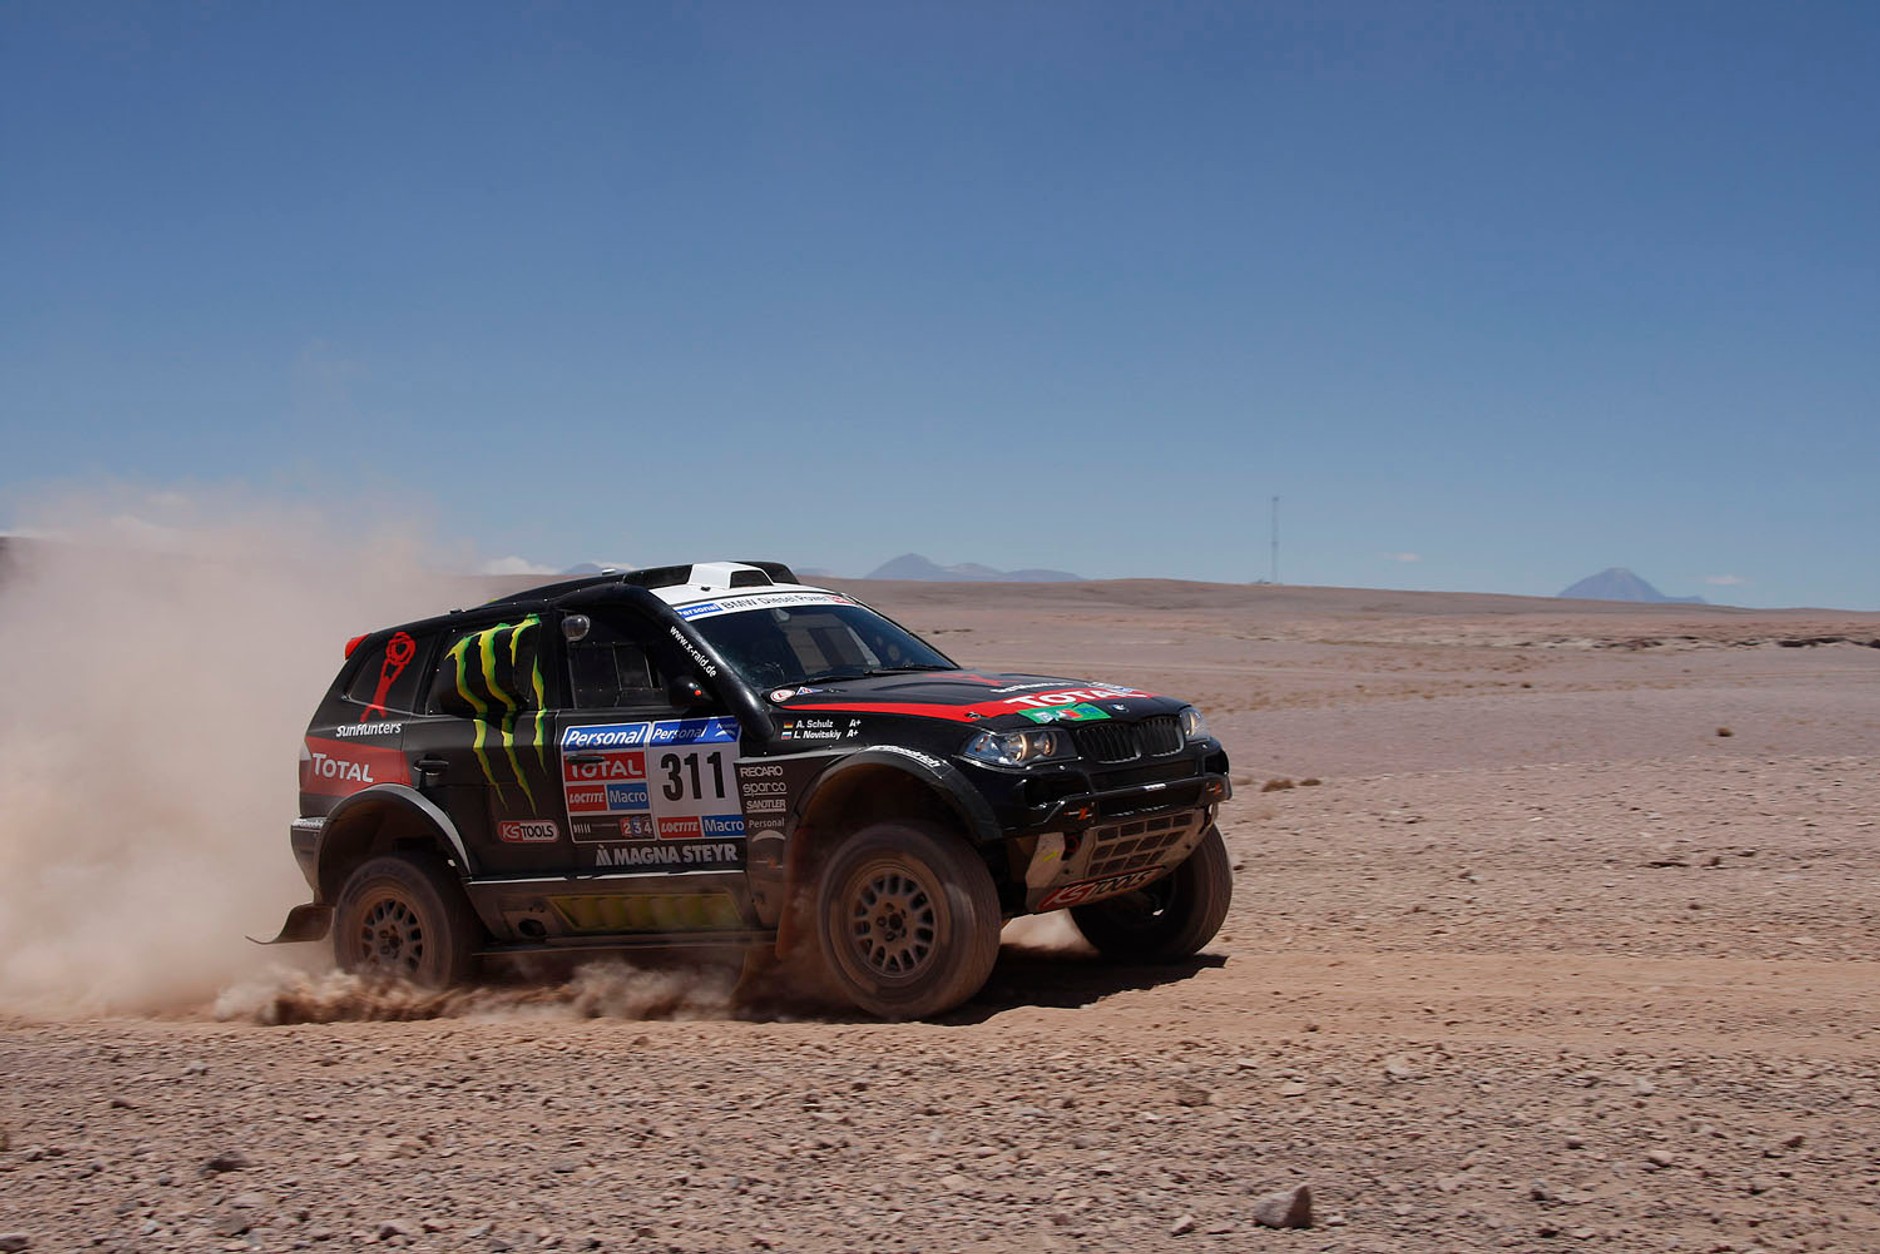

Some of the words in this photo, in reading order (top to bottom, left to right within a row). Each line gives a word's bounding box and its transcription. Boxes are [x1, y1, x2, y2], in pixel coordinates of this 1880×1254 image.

[721, 598, 757, 610] BMW
[670, 625, 717, 678] www.x-raid.de
[796, 720, 805, 728] A.
[807, 719, 833, 728] Schulz
[849, 719, 861, 727] A+
[566, 725, 646, 747] Personal
[652, 725, 709, 741] Personal
[803, 729, 842, 740] Novitskiy
[847, 729, 858, 738] A+
[312, 753, 374, 783] TOTAL
[571, 759, 643, 779] TOTAL
[660, 751, 726, 801] 311
[740, 765, 783, 778] RECARO
[569, 790, 605, 804] LOCTITE
[609, 789, 648, 802] Macro
[743, 781, 787, 797] sparco
[661, 820, 699, 833] LOCTITE
[704, 818, 745, 832] Macro
[748, 818, 785, 829] Personal
[614, 845, 681, 866] MAGNA
[682, 843, 738, 863] STEYR
